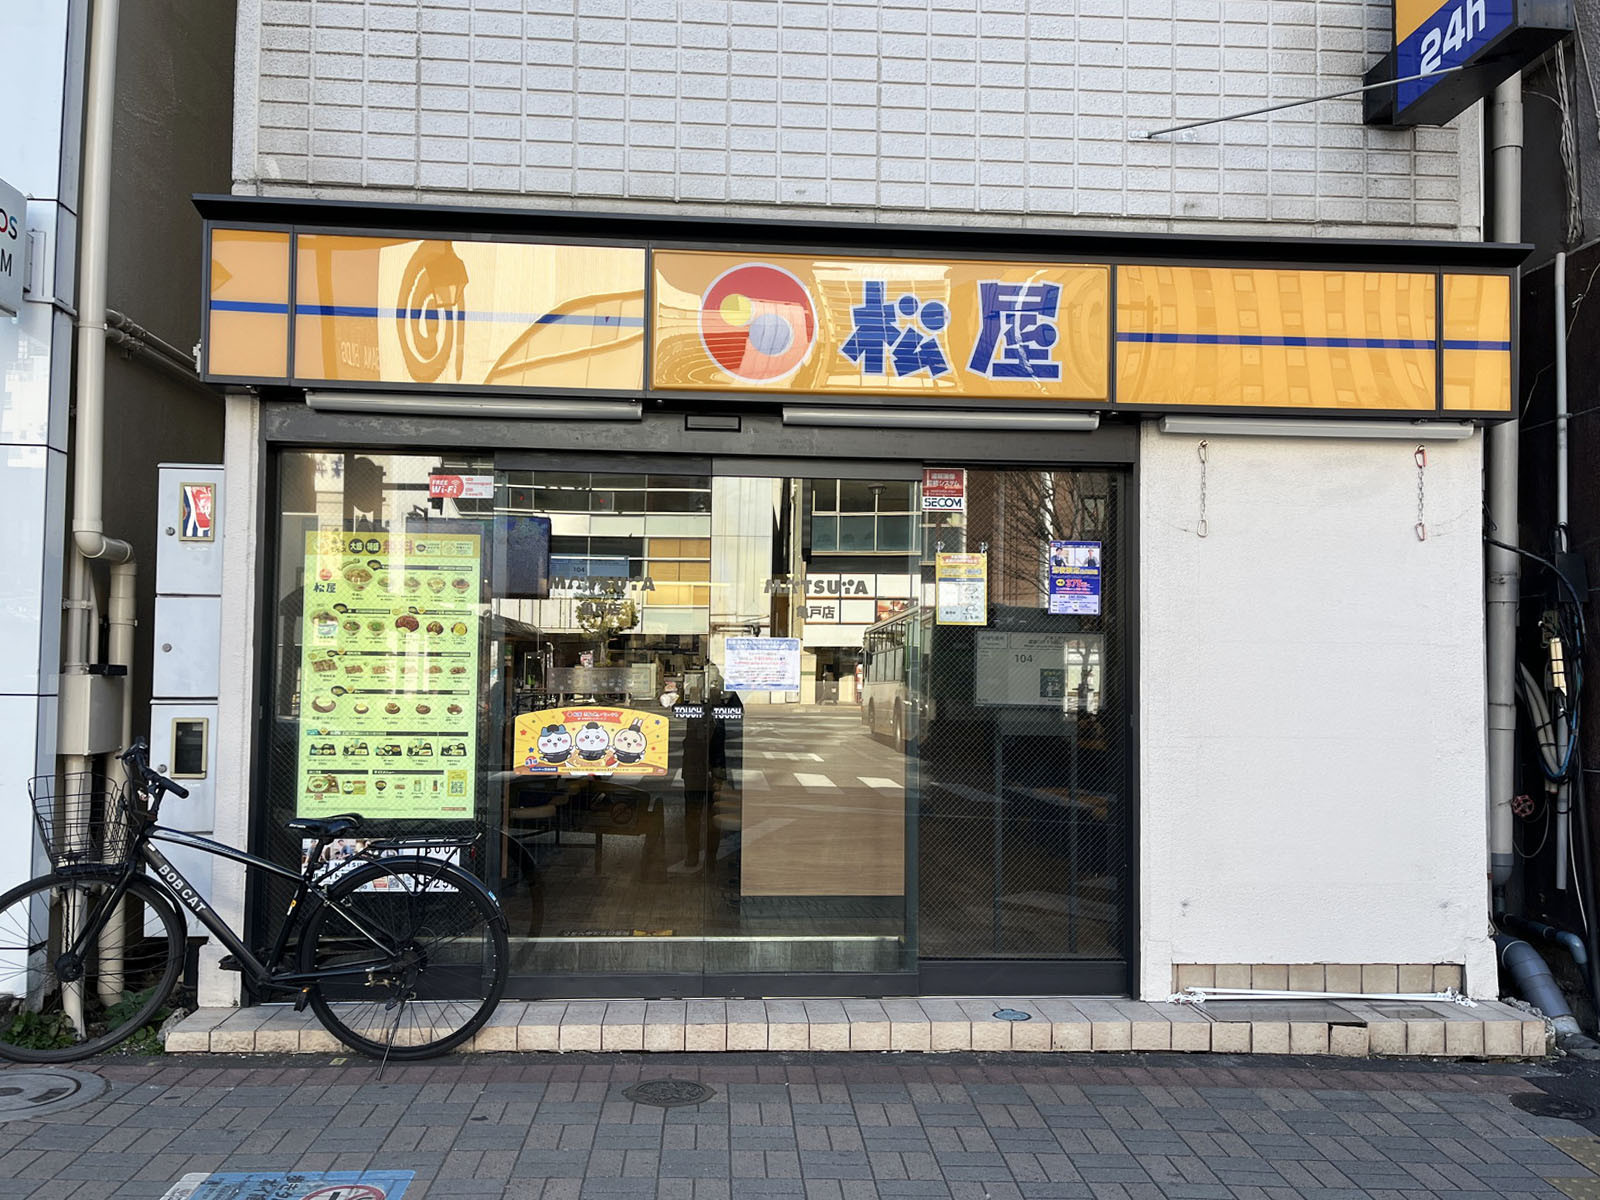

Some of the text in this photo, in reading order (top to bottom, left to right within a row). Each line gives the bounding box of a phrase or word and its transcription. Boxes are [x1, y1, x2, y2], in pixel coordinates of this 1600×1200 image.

[1420, 0, 1486, 77] 24h
[837, 278, 1064, 383] 松屋
[432, 485, 458, 494] Wi-Fi
[924, 497, 962, 508] SECOM
[313, 582, 337, 594] 松屋
[797, 605, 836, 620] 亀戸店
[1014, 654, 1033, 663] 104
[674, 707, 703, 719] TOUCH
[713, 708, 742, 720] TOUCH
